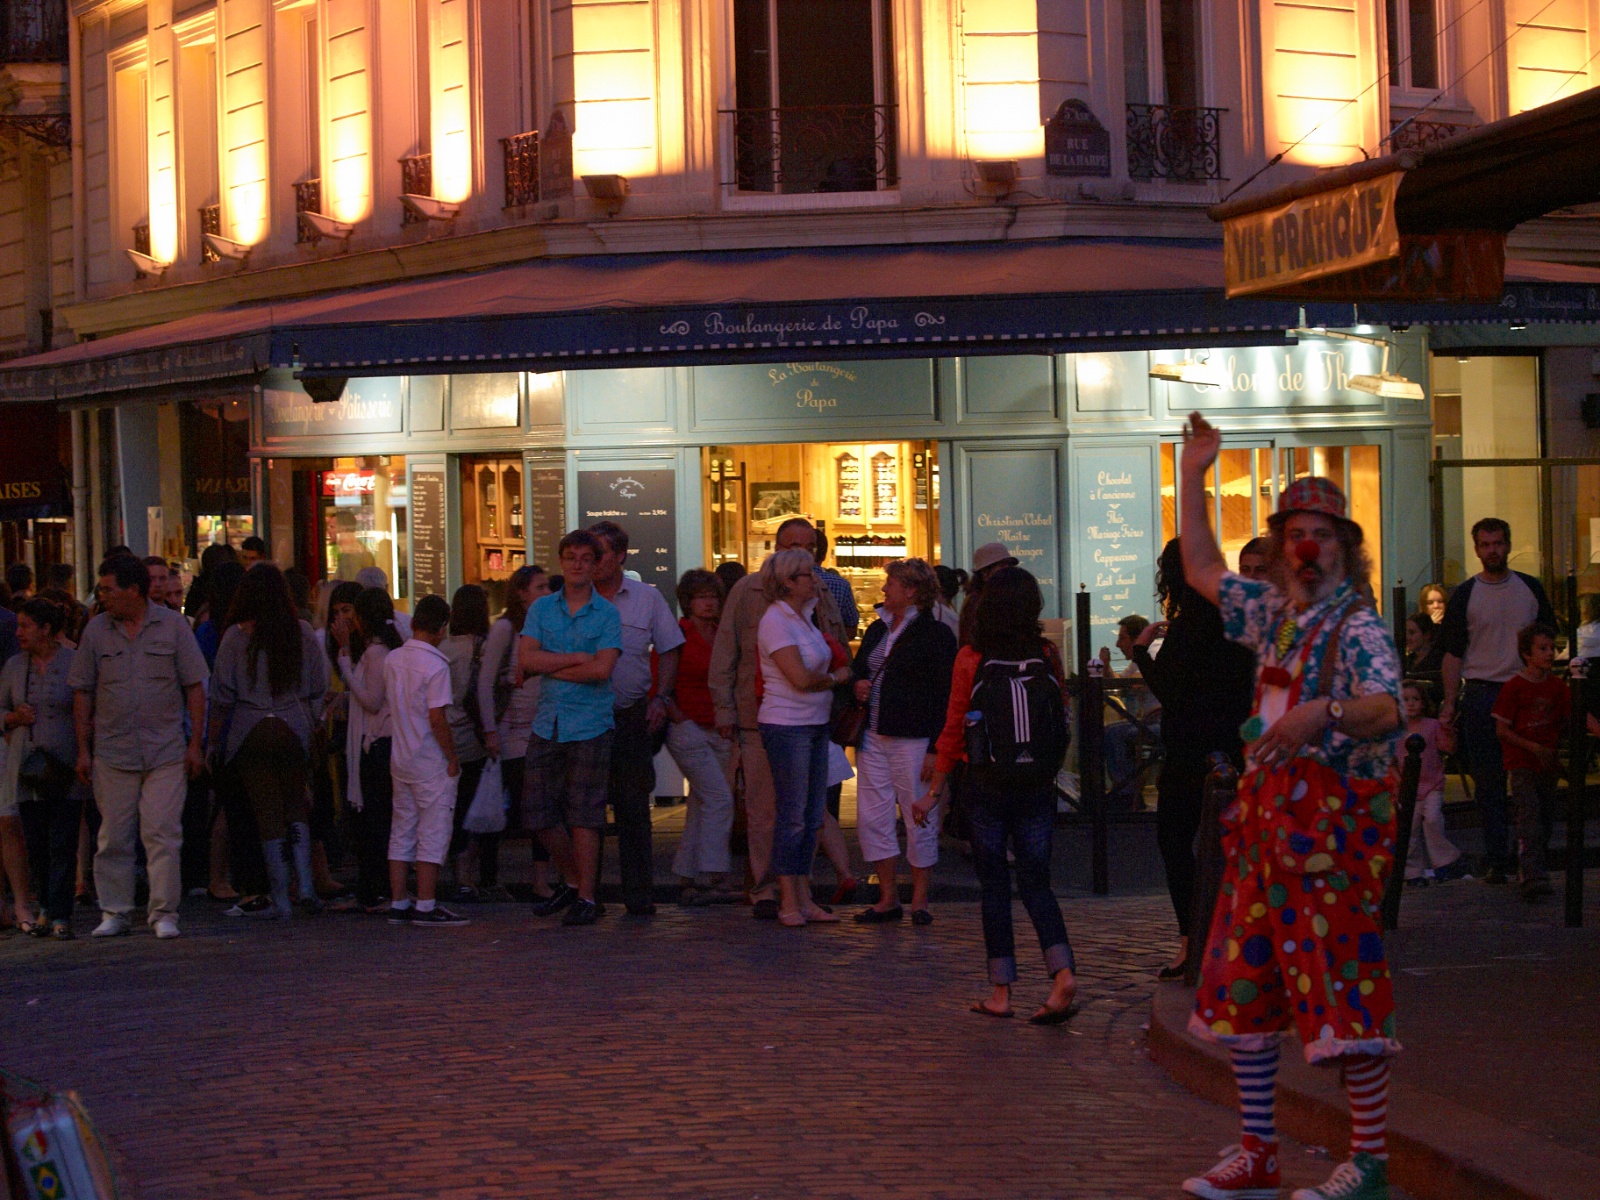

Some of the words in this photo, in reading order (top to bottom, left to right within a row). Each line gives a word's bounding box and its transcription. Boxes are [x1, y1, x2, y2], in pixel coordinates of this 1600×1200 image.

[1067, 138, 1089, 150] RUE
[1230, 223, 1267, 283] VIE
[1272, 185, 1383, 274] PRATIQUE
[704, 312, 817, 343] Boulangerie
[821, 315, 842, 331] de
[850, 306, 899, 335] Papa
[768, 368, 787, 387] La
[786, 362, 858, 383] Boulangerie
[810, 378, 820, 387] de
[1278, 354, 1304, 393] de
[338, 387, 393, 422] Pâtisserie
[796, 388, 837, 412] Papa
[1097, 470, 1132, 486] Chocolat
[977, 513, 1022, 527] Christian
[1094, 548, 1138, 567] Cappuccino
[1095, 573, 1113, 587] Lait
[1115, 573, 1136, 586] chaud
